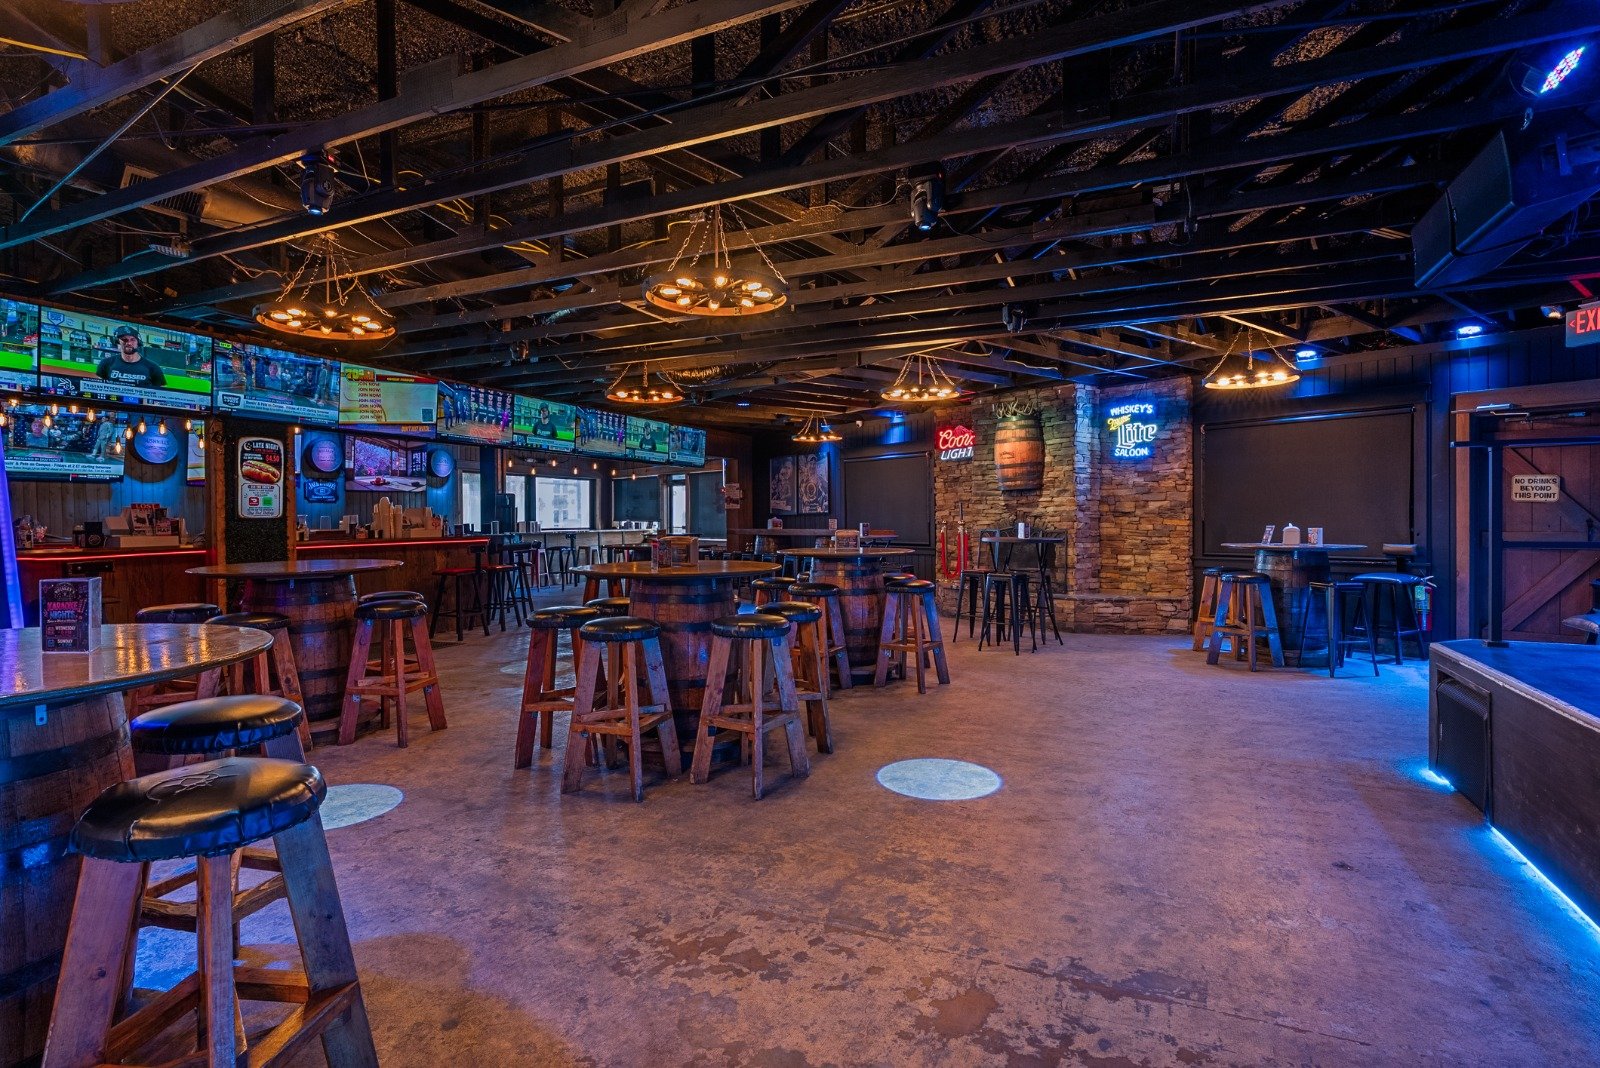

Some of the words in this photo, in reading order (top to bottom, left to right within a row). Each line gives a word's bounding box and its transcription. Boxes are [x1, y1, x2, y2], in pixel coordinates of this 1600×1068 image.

[1576, 308, 1600, 334] EXI
[1110, 403, 1153, 416] WHISKEY'S
[1116, 423, 1157, 449] Lite
[1114, 447, 1149, 457] SALOON
[46, 602, 77, 611] KARAOKE
[50, 610, 76, 620] NIGHTS
